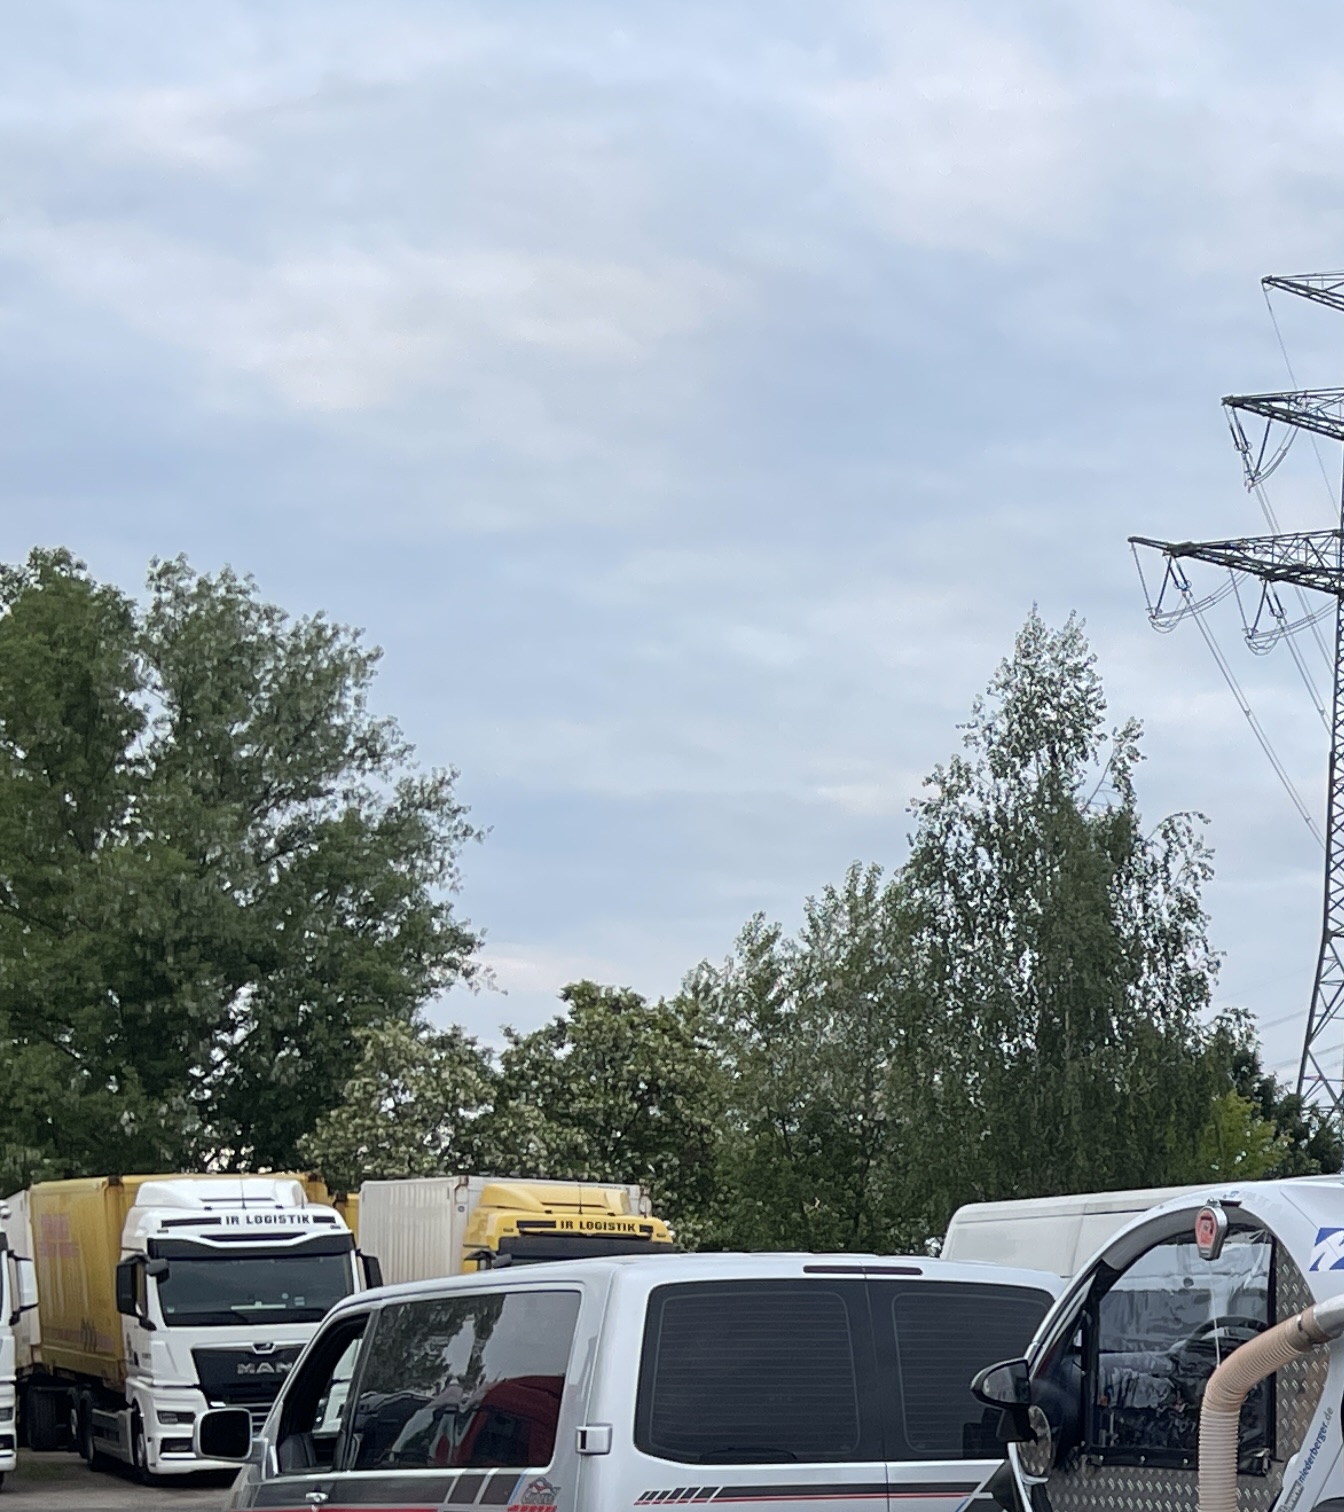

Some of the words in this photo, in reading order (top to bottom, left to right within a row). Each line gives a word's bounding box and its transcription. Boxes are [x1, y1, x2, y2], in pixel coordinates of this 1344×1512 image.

[226, 1215, 239, 1225] IR
[246, 1214, 310, 1225] LOGISTIK
[560, 1220, 574, 1230] IR
[580, 1220, 636, 1232] LOGISTIK
[237, 1362, 293, 1374] MAN
